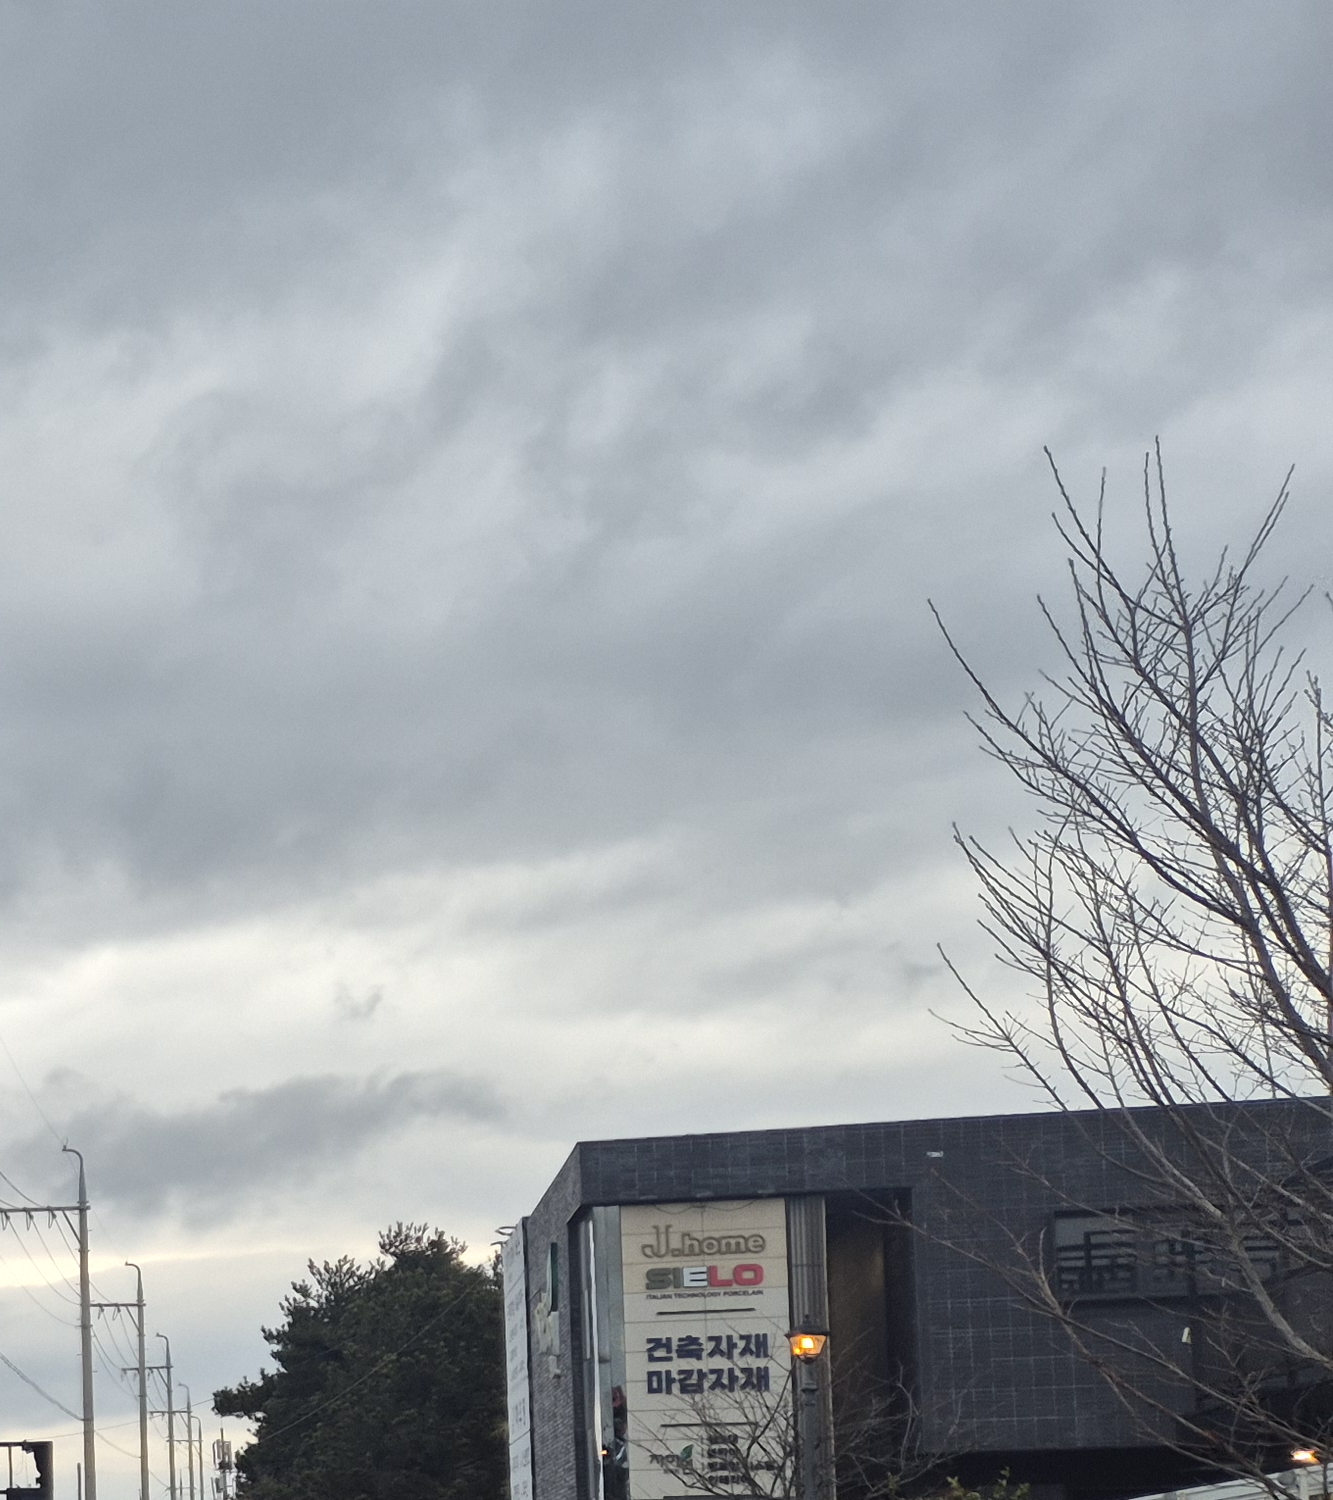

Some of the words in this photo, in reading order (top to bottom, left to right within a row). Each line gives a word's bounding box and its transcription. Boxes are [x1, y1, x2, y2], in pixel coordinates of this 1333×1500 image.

[645, 1263, 764, 1290] SIELO
[645, 1332, 769, 1363] 건축자재
[646, 1366, 770, 1395] 마감자재
